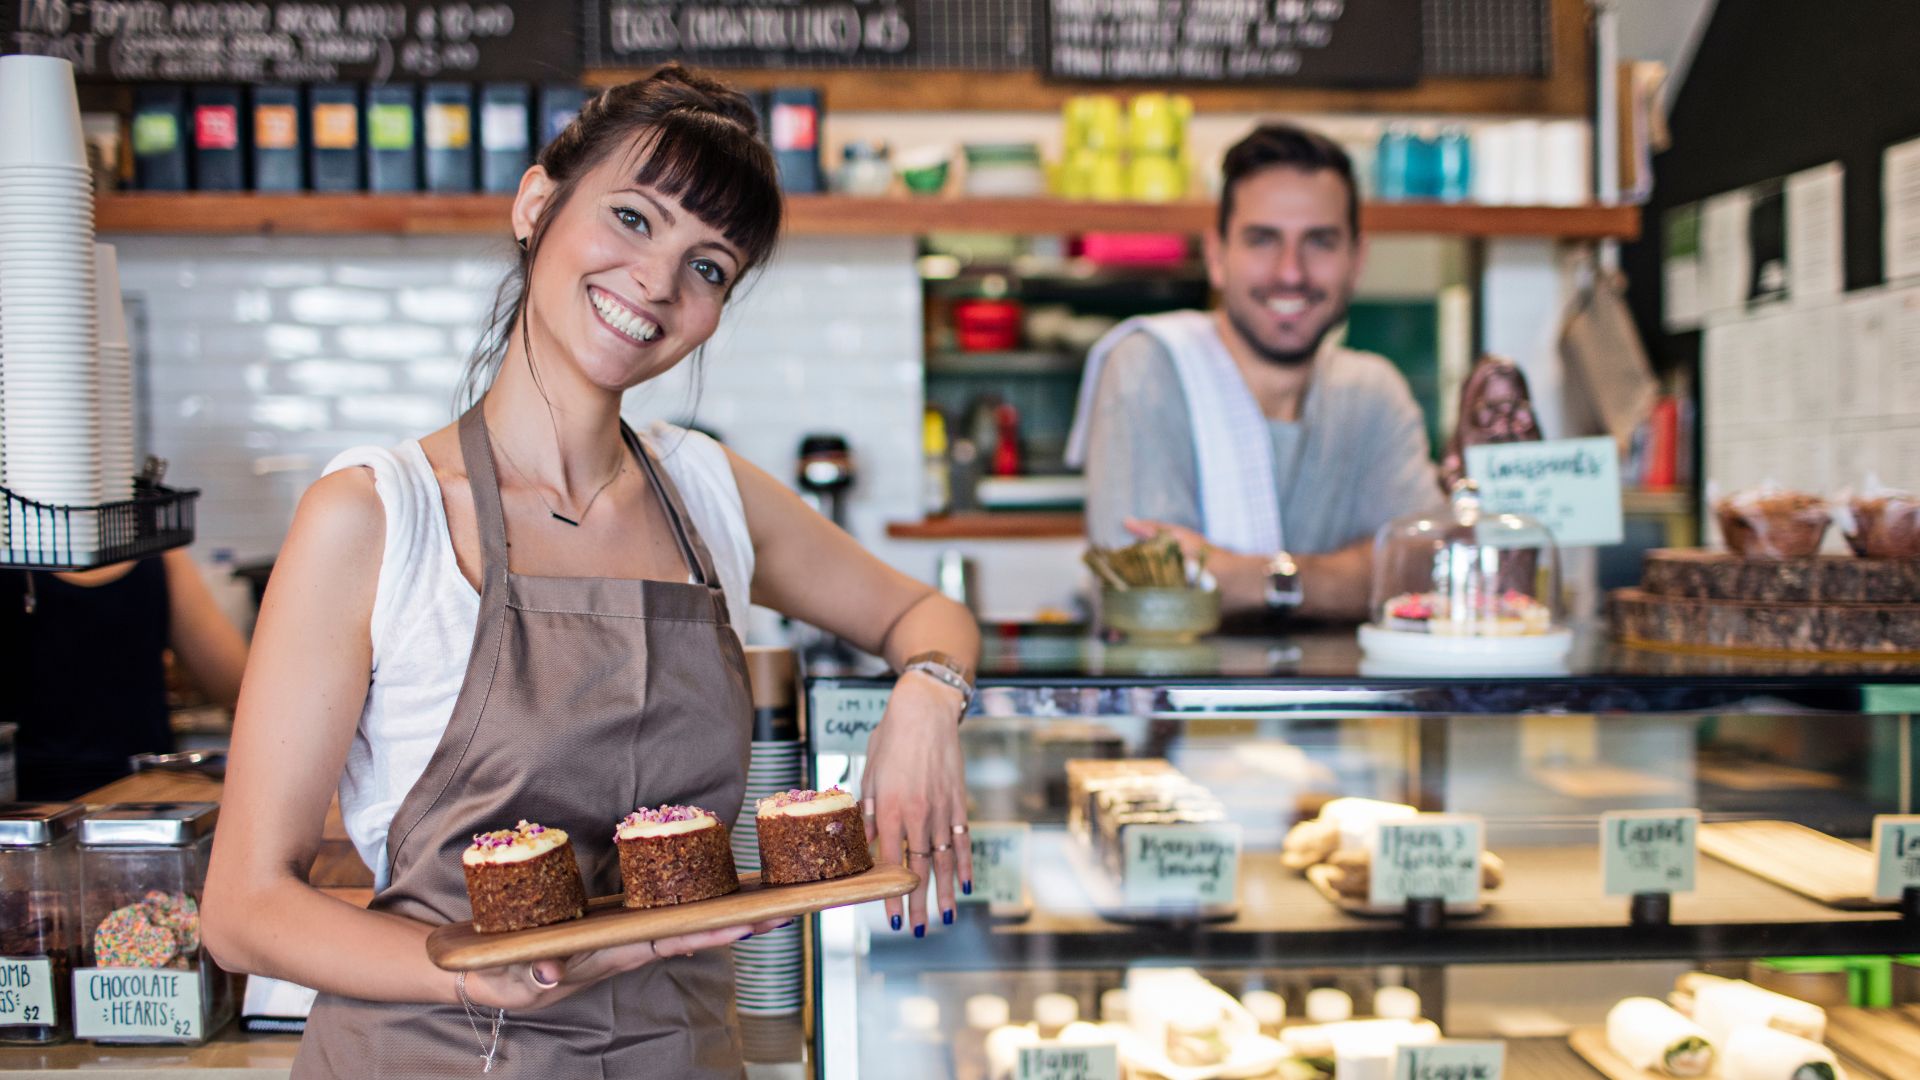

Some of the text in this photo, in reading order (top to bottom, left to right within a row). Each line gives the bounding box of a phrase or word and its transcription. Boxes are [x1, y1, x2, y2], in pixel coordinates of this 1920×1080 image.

[89, 974, 180, 1001] CHOCOLATE
[23, 1005, 40, 1022] $2
[111, 1000, 168, 1026] HEARTS
[173, 1019, 192, 1036] $2
